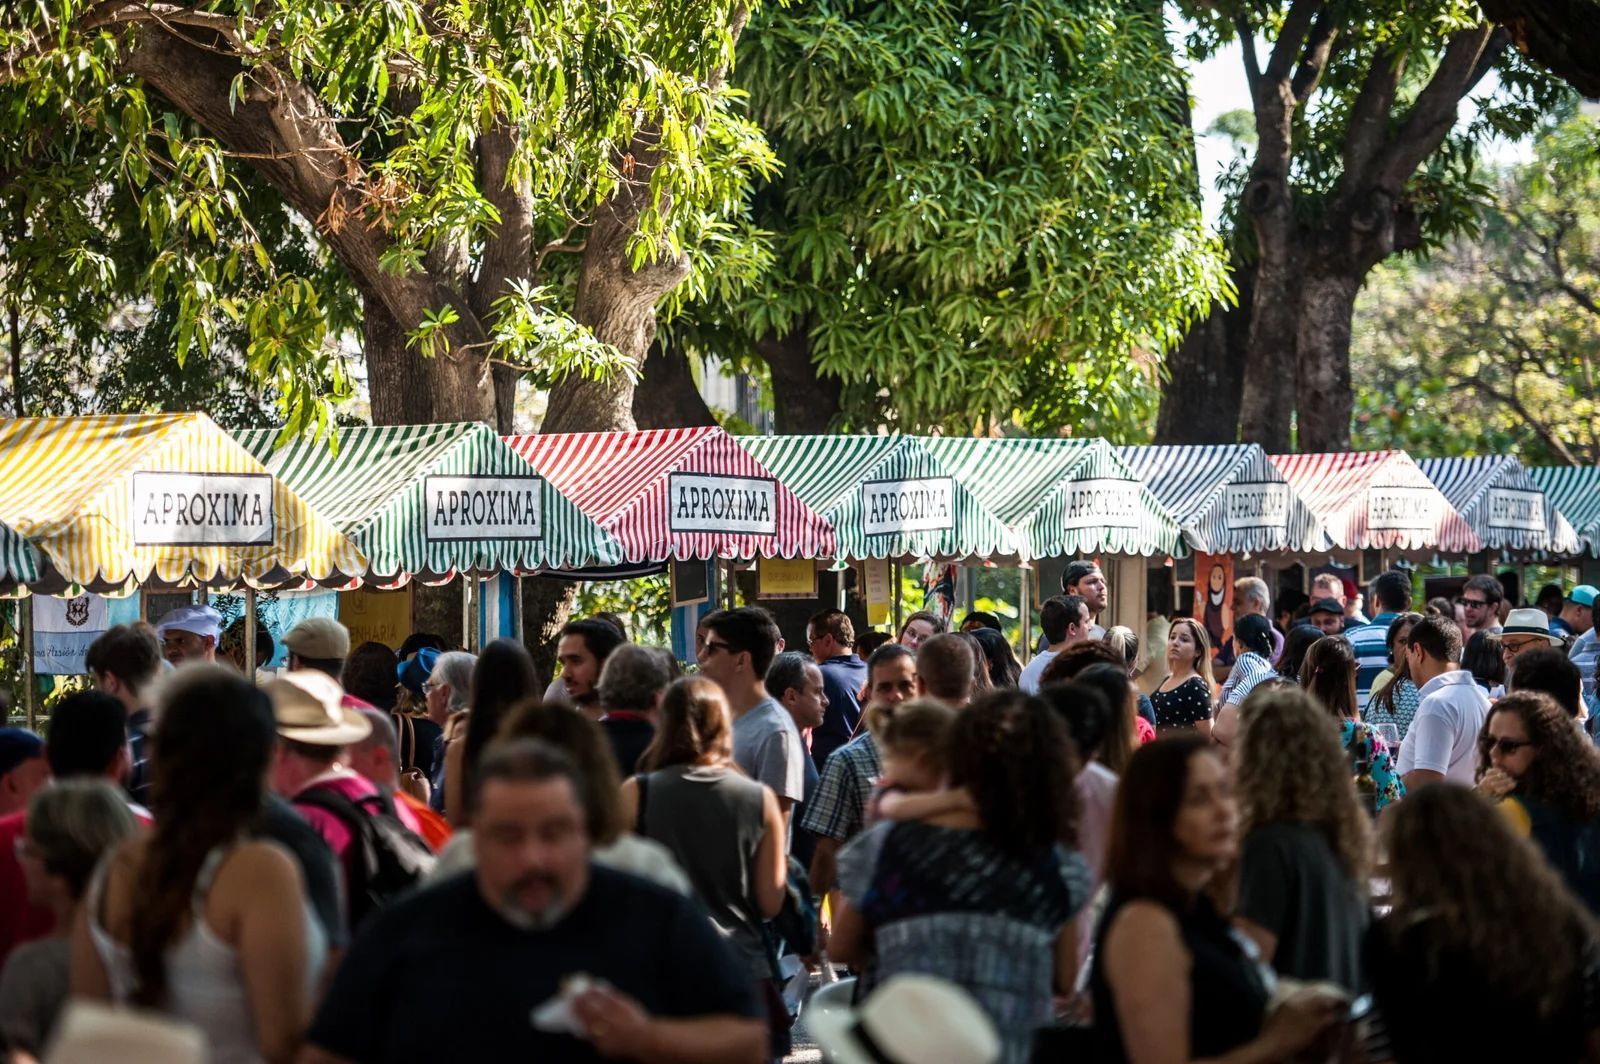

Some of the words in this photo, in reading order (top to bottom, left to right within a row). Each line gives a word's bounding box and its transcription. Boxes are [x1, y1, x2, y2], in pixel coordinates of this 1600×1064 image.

[143, 492, 263, 526] APROXIMA
[434, 490, 535, 526] APROXIMA
[676, 486, 770, 522] APROXIMA
[869, 488, 947, 524] APROXIMA
